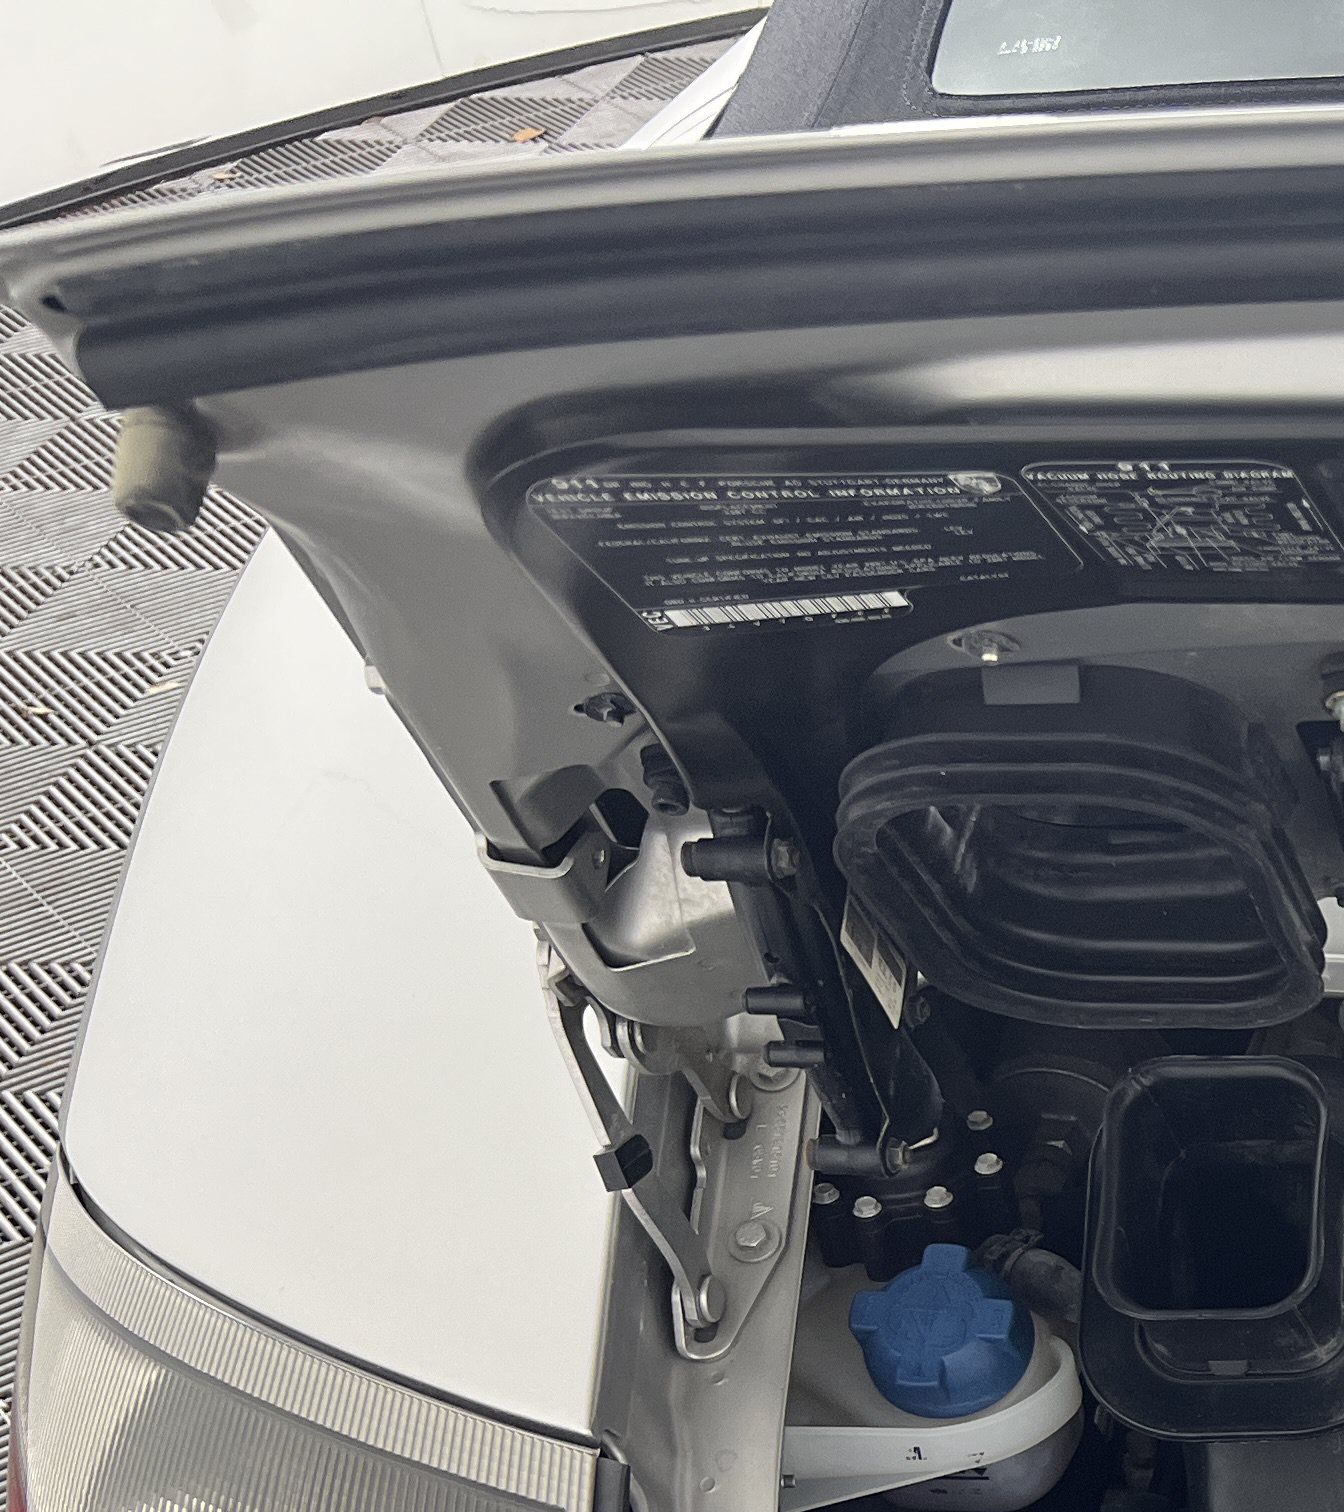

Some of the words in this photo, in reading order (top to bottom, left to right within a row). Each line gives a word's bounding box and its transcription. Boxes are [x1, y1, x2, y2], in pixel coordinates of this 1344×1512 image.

[1118, 462, 1170, 471] 911
[1025, 470, 1090, 480] VACUUM
[1096, 471, 1138, 480] HOSE
[1146, 470, 1217, 480] ROUTING
[1223, 469, 1294, 479] DIAGRAM
[551, 478, 600, 490] 911
[532, 492, 615, 502] VEHICLE
[623, 491, 718, 501] EMISSION
[728, 488, 822, 499] CONTROL
[829, 486, 961, 498] INFORMATION
